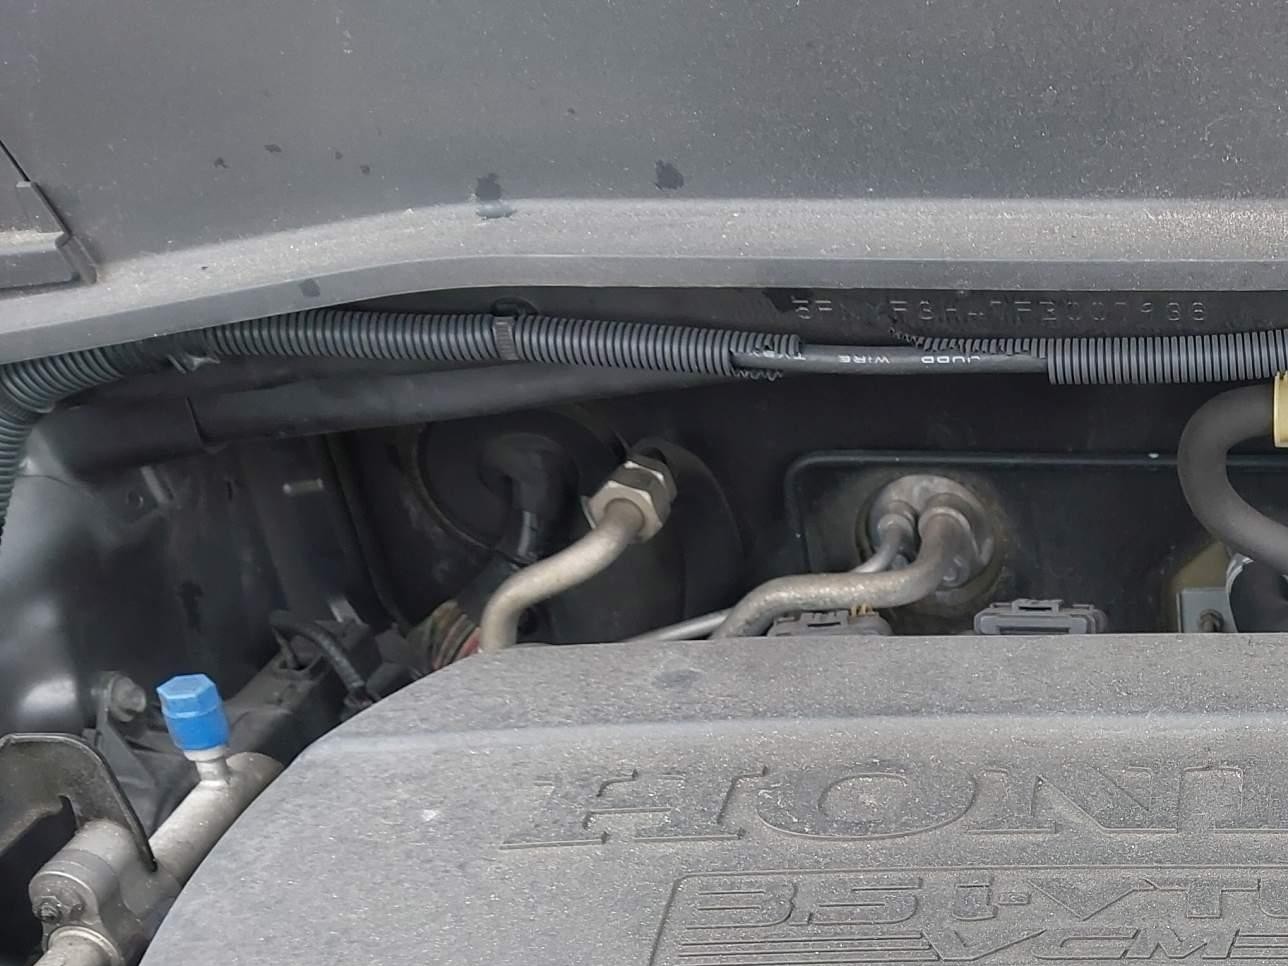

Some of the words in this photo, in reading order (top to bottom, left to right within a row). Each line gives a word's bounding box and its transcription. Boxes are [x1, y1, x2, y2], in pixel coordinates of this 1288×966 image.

[838, 354, 890, 364] WIRE
[921, 354, 981, 364] JUDD
[920, 928, 1241, 961] VCM
